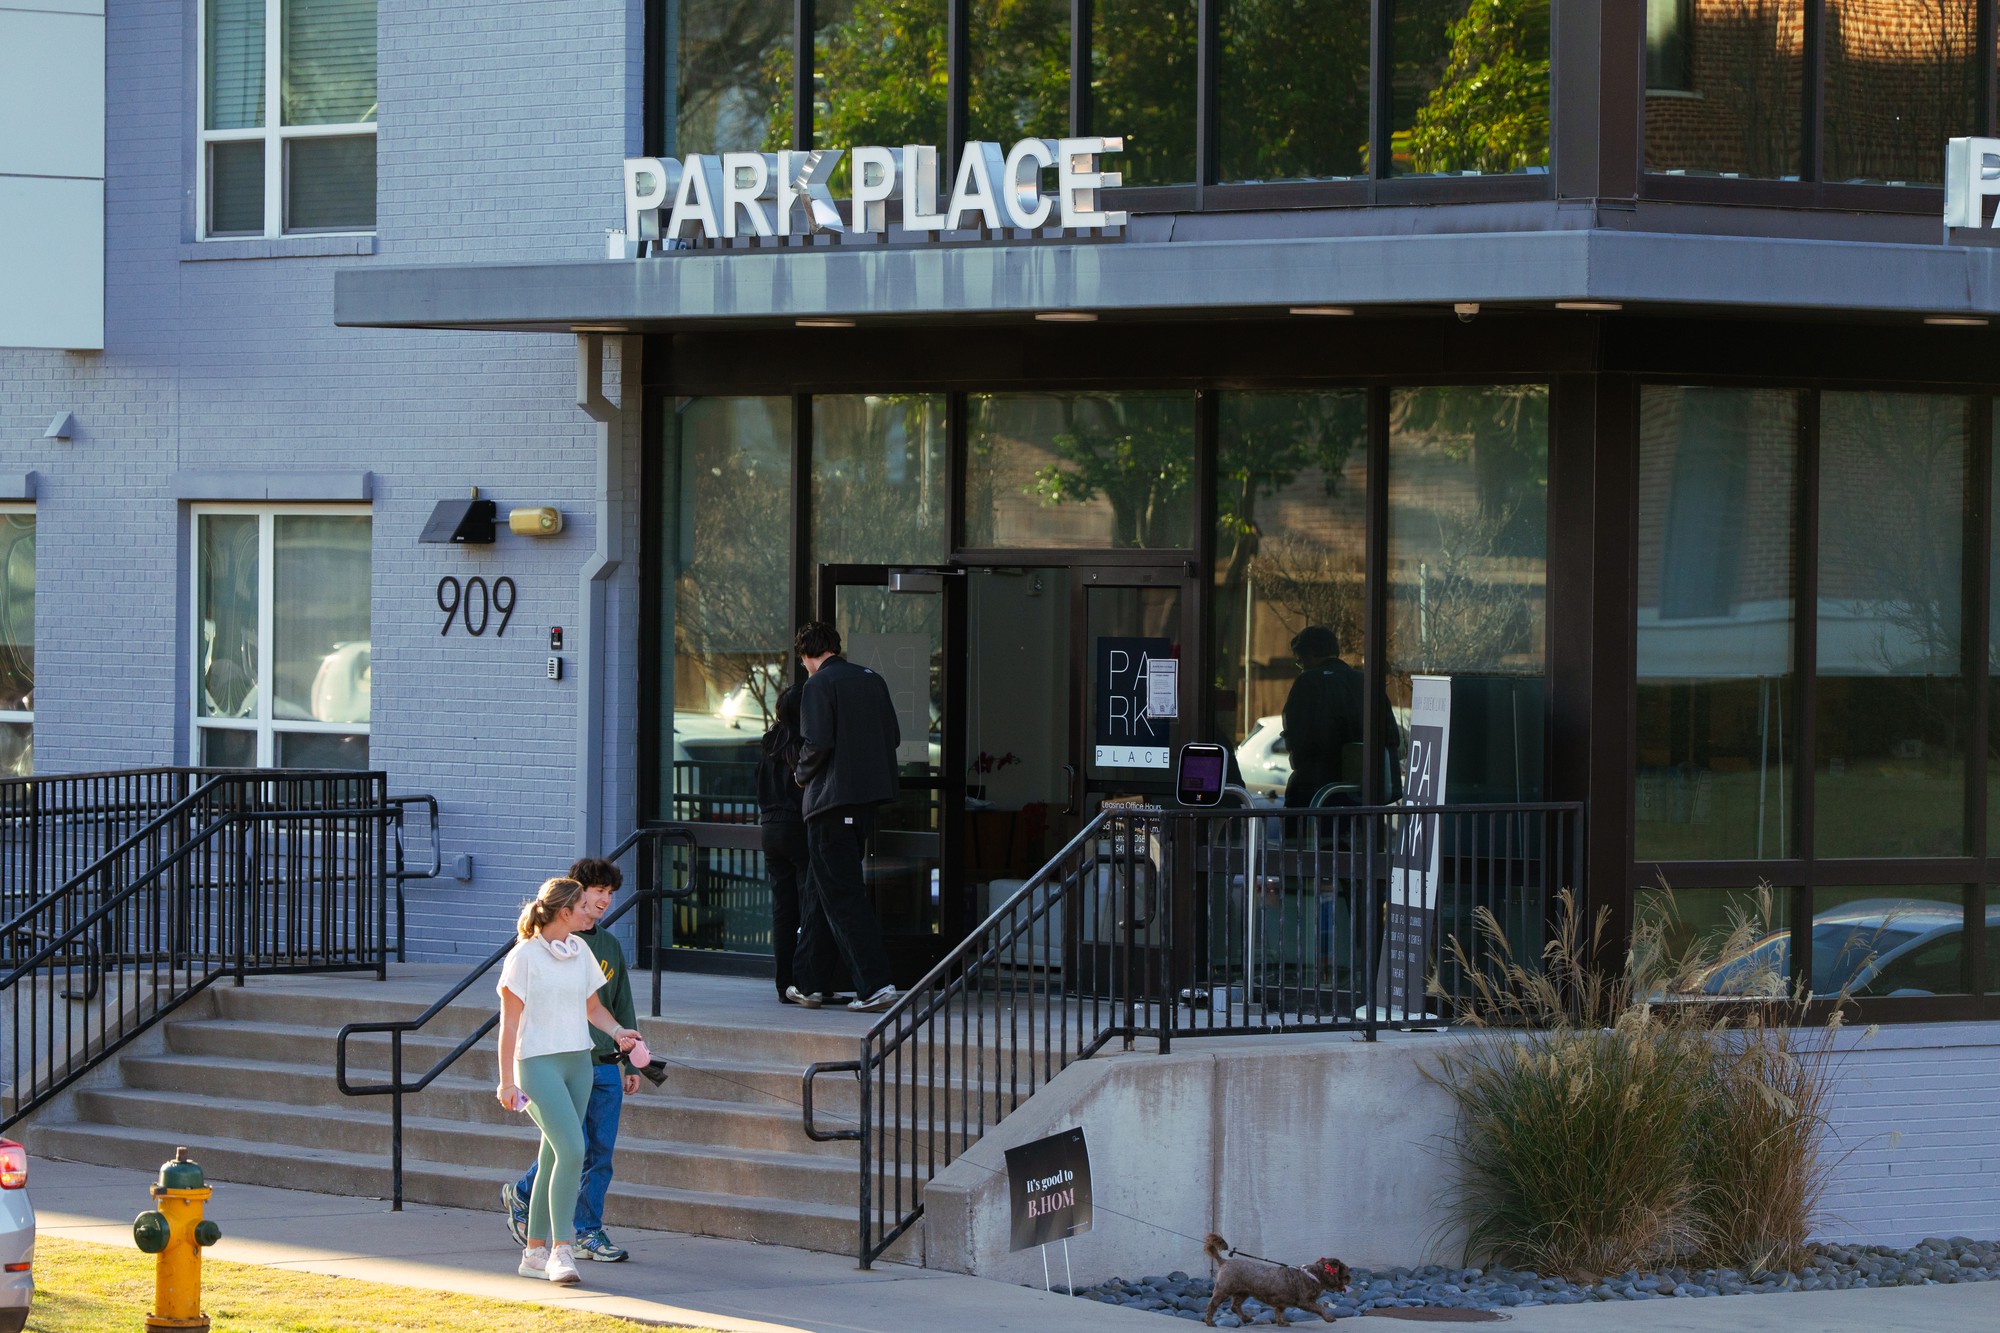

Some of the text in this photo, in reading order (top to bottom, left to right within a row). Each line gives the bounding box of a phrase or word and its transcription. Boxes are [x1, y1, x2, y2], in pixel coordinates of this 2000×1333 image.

[624, 137, 1127, 241] PARK PLACE
[437, 576, 516, 637] 909
[1109, 650, 1148, 690] PA
[1109, 695, 1155, 736] RK
[1096, 750, 1169, 764] PLACE
[1407, 740, 1432, 797] PA
[1101, 800, 1162, 811] Leasing Office Hours
[1026, 1169, 1074, 1194] It's good to
[1028, 1187, 1075, 1218] B.HOM
